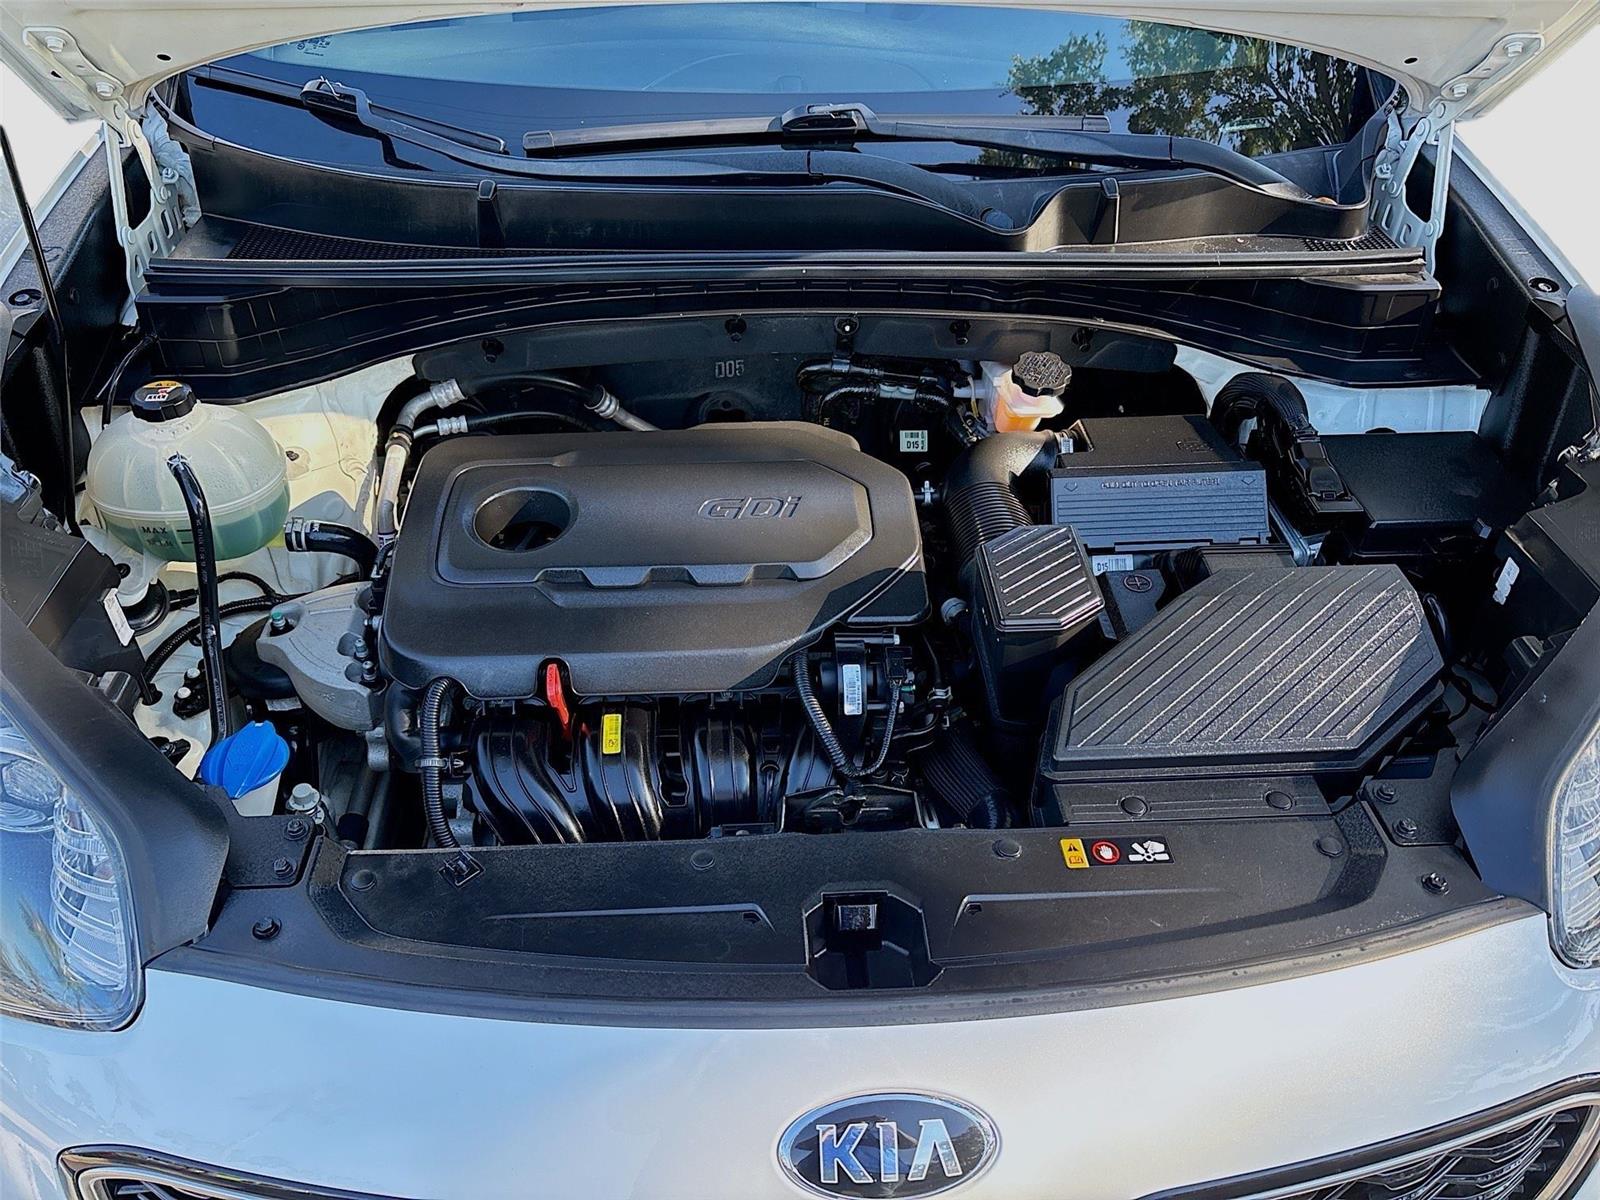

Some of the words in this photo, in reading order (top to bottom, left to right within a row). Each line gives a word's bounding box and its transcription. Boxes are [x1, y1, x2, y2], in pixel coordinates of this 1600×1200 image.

[697, 496, 802, 519] GDi
[141, 526, 168, 534] MAX
[816, 1119, 963, 1184] KIA
